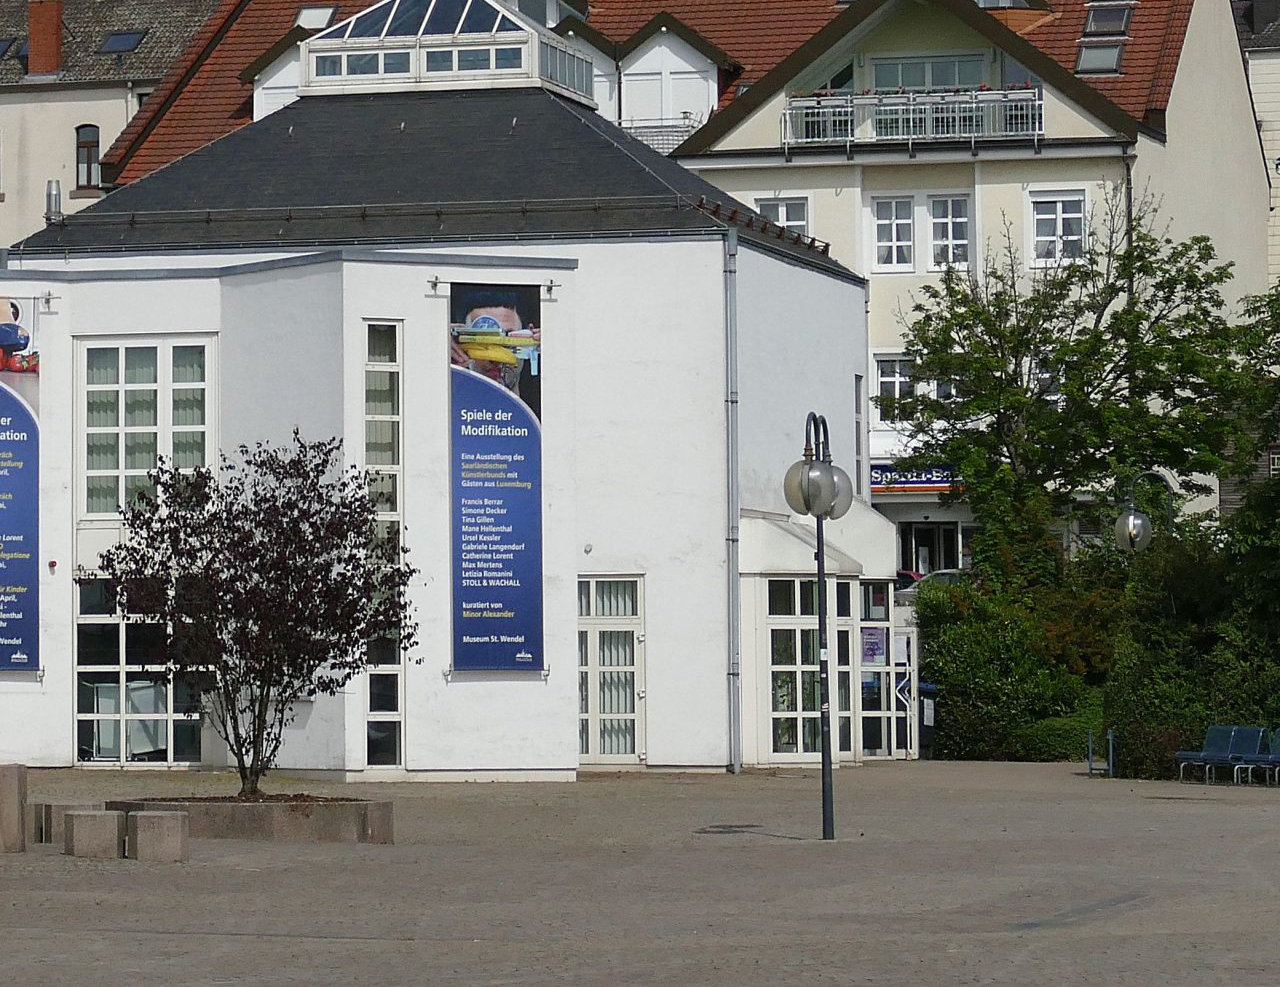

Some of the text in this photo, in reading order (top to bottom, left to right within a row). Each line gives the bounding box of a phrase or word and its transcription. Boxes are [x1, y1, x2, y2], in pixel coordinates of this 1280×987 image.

[461, 409, 512, 422] Spiele der
[461, 425, 528, 436] Modifikation
[476, 453, 512, 462] Ausstellung
[496, 480, 532, 489] Luxemburg
[489, 543, 525, 551] Langendorf
[462, 601, 489, 609] kuratiert
[482, 610, 515, 618] Alexander
[500, 635, 524, 643] Wendel
